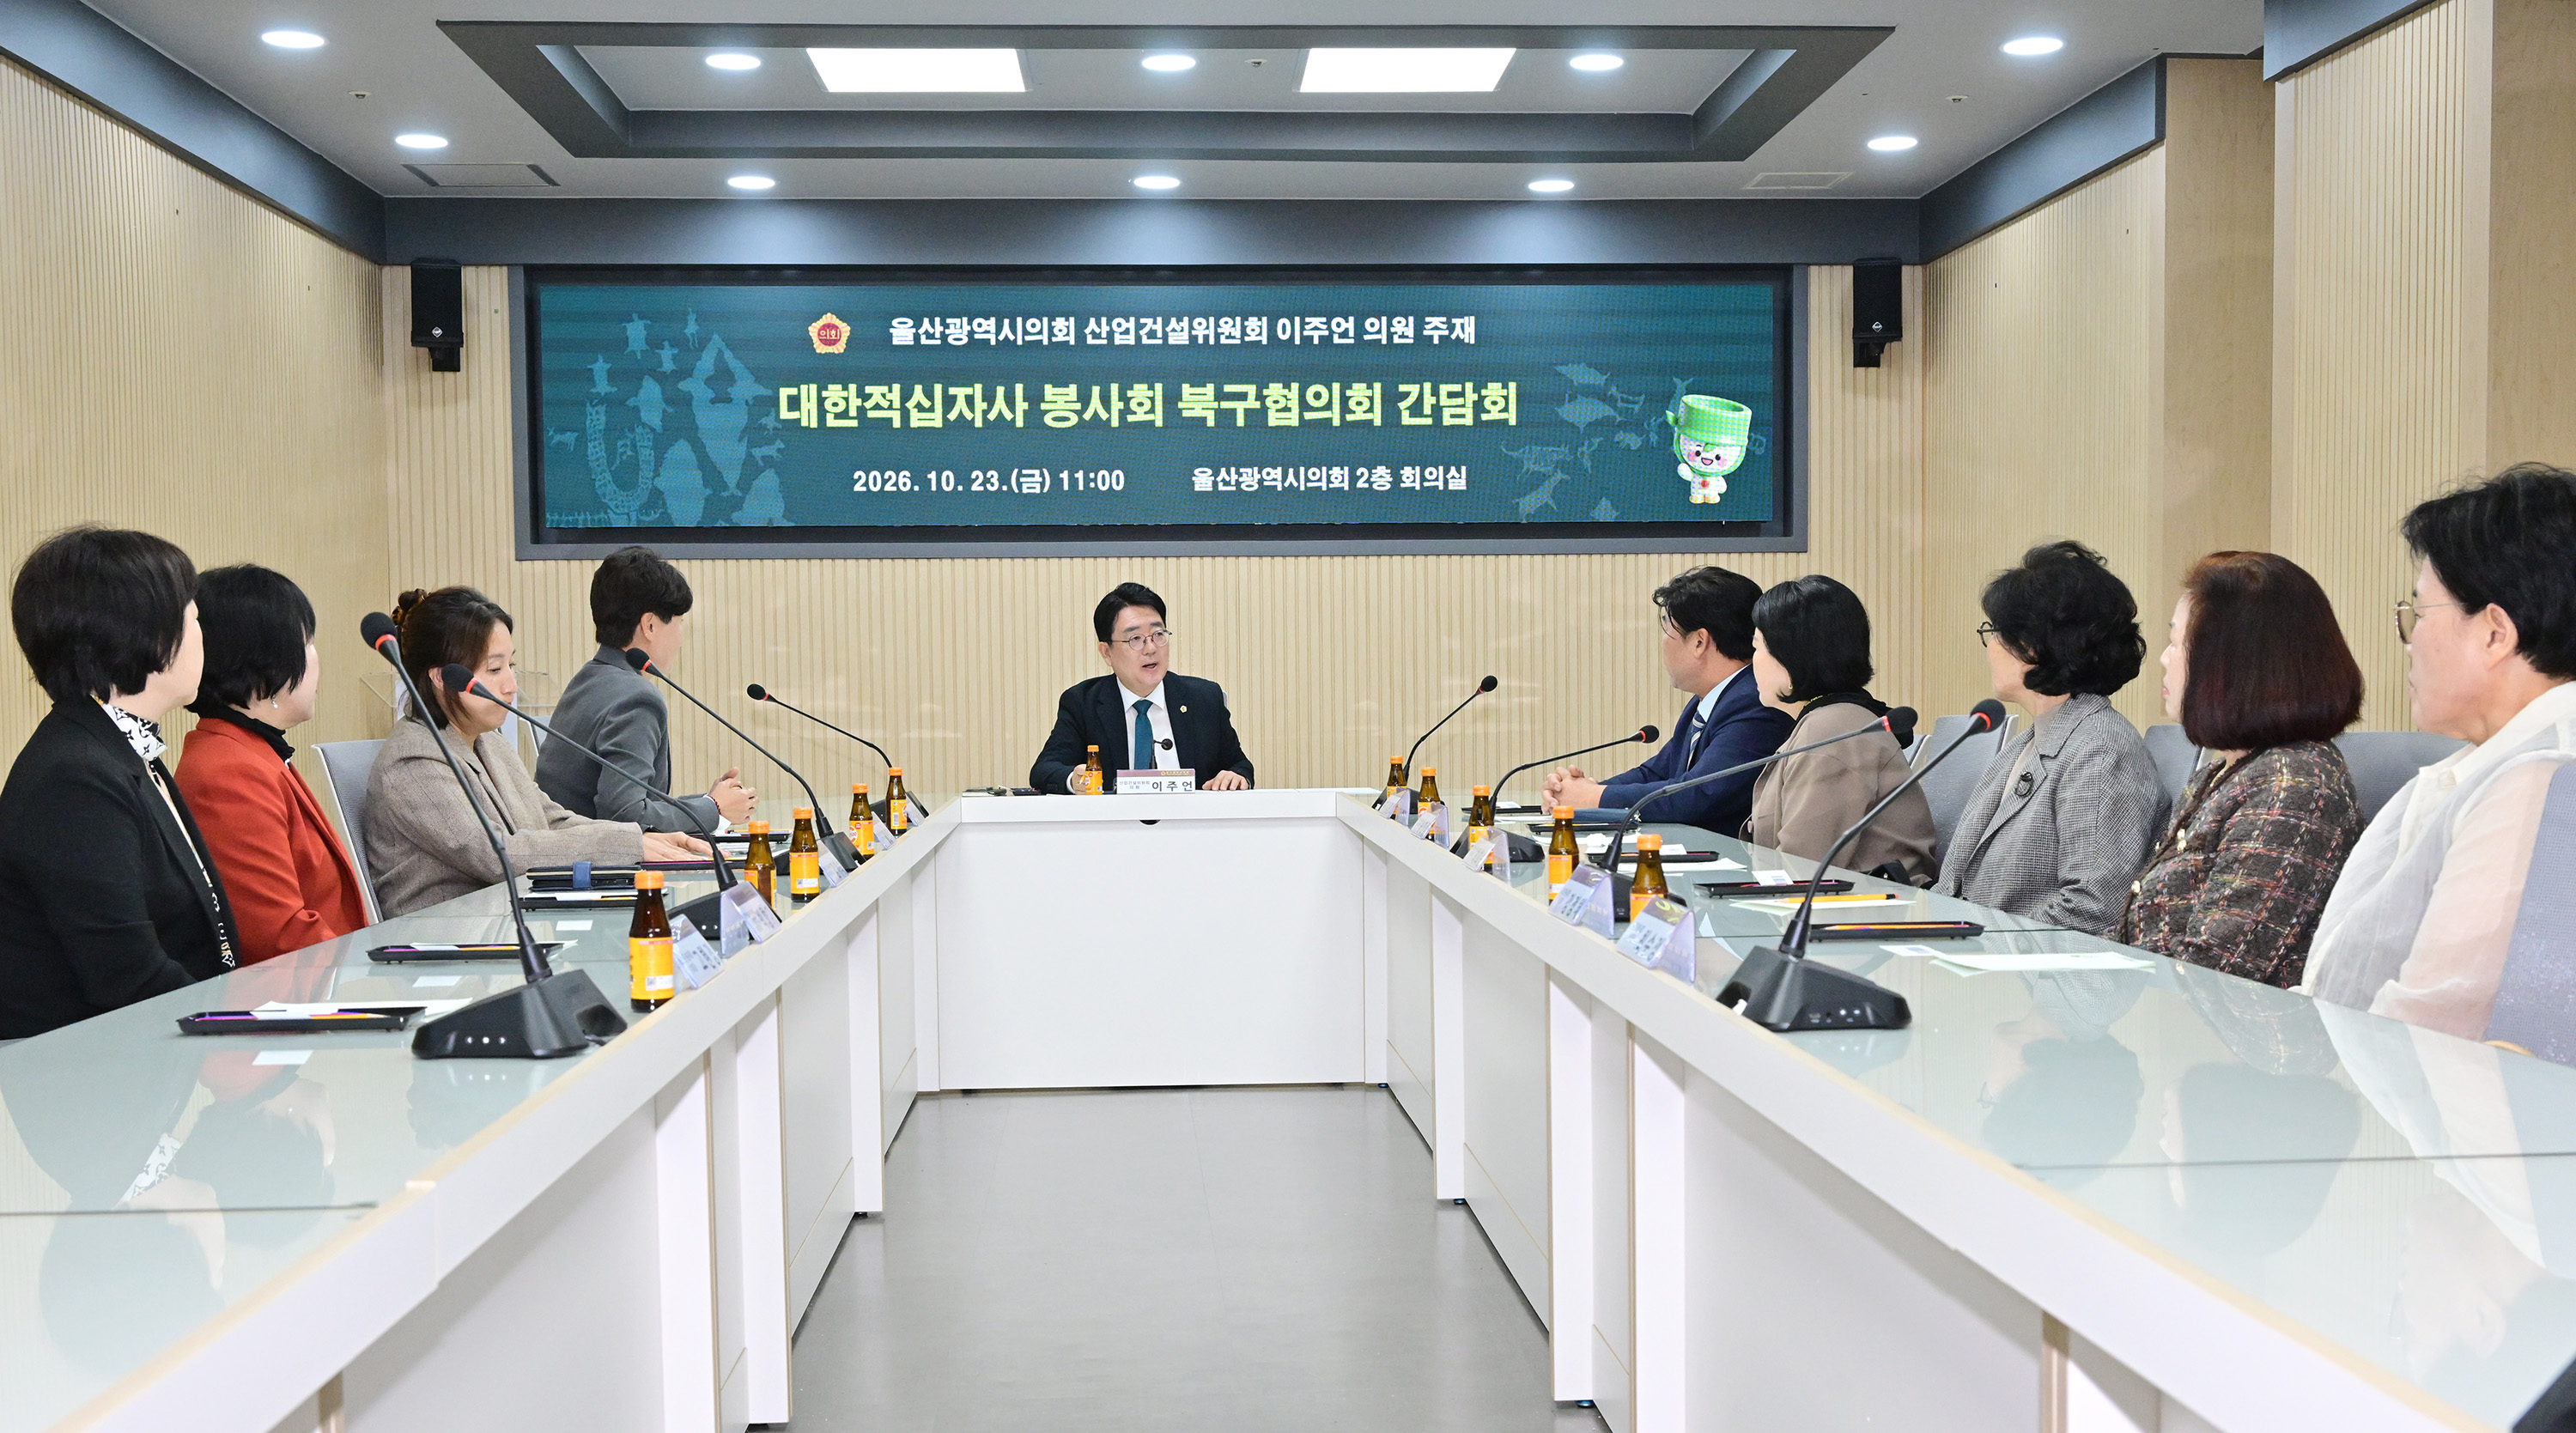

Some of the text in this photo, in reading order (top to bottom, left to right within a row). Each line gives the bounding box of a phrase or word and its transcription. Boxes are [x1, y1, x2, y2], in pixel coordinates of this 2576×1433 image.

[819, 329, 840, 340] 의회
[889, 316, 1475, 345] 울산광역시의회 산업건설위원회 이주언 의원 주재
[779, 381, 1517, 428] 대한적십자사 봉사회 북구협의회 간담회
[853, 468, 1125, 494] 2026. 10. 23.(금) 11:00
[1192, 465, 1467, 492] 울산광역시의회 2층 회의실
[1151, 780, 1193, 792] 이주언
